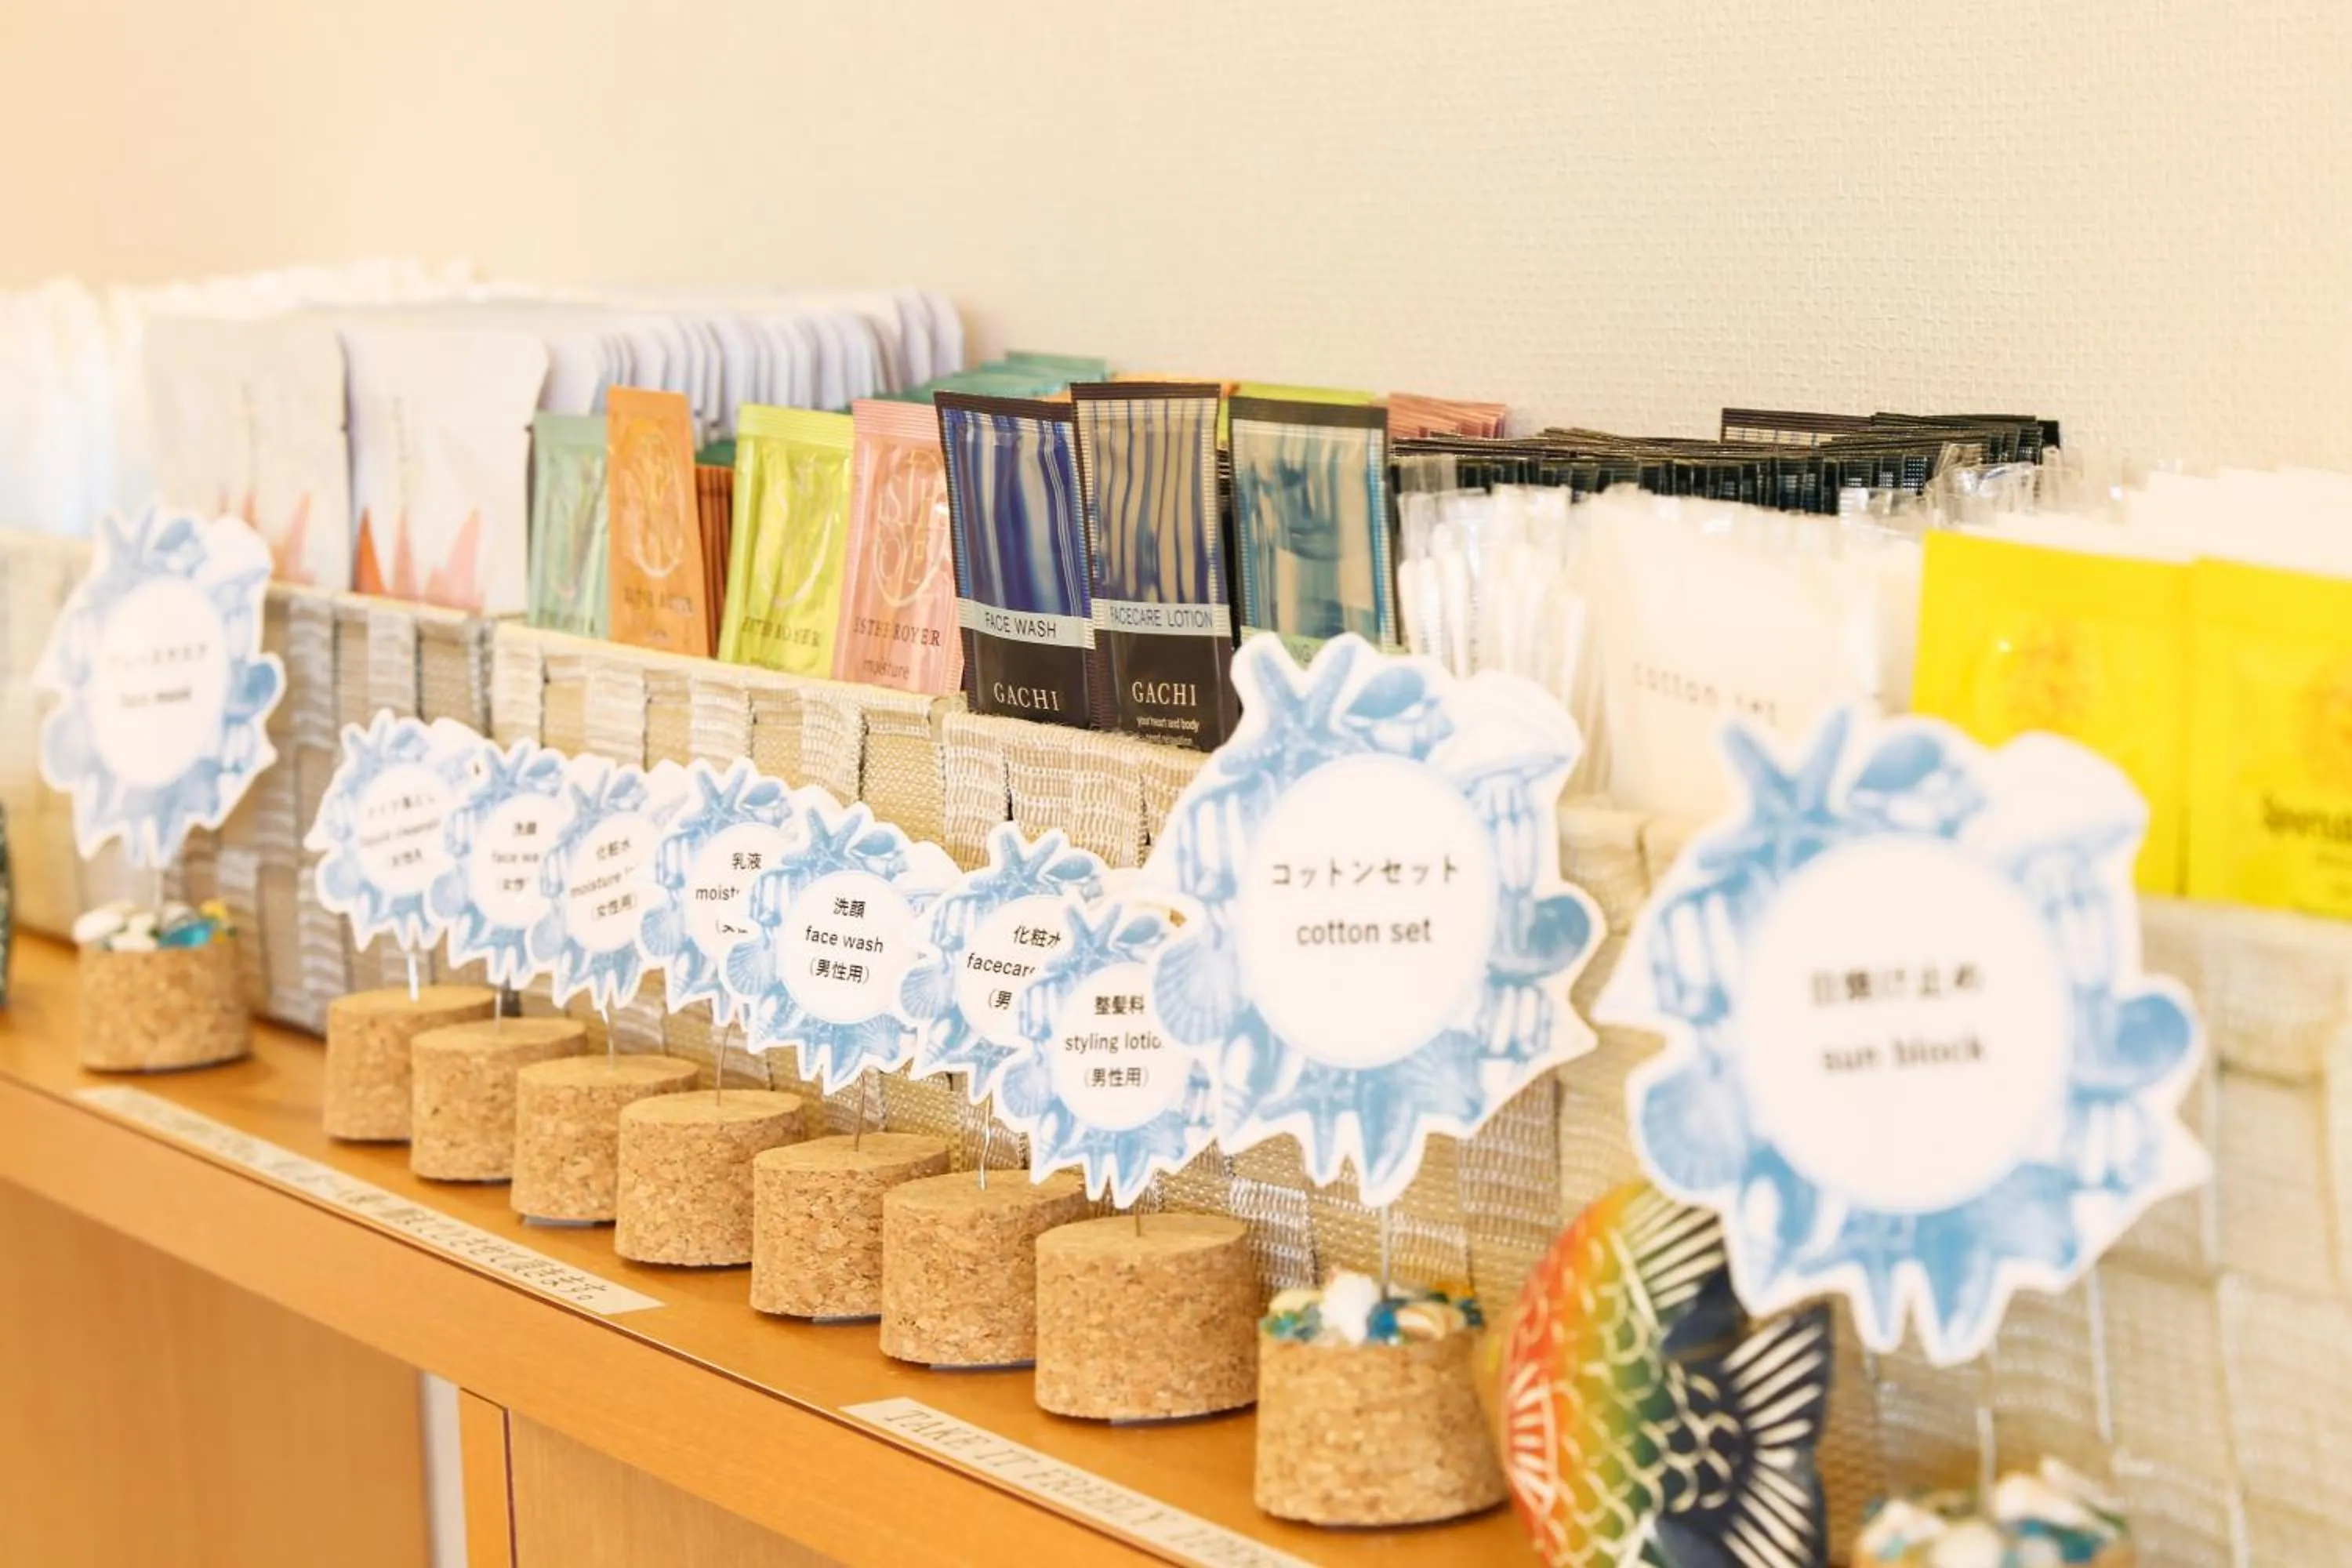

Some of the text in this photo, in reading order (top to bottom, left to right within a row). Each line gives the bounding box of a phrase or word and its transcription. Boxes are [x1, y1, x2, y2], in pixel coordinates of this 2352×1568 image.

[985, 612, 1057, 638] FACE WASH
[1166, 609, 1213, 628] LOTION
[993, 681, 1060, 711] GACHI
[1131, 681, 1197, 706] GACHI
[731, 852, 763, 871] 乳液
[1272, 854, 1458, 888] コットンセット
[695, 884, 740, 902] moist
[833, 896, 866, 919] 洗顔
[805, 924, 884, 954] face wash
[1296, 916, 1433, 946] cotton set
[809, 957, 870, 985] (男性用)
[1065, 1033, 1120, 1055] styling
[1083, 1065, 1151, 1088] (男性用)
